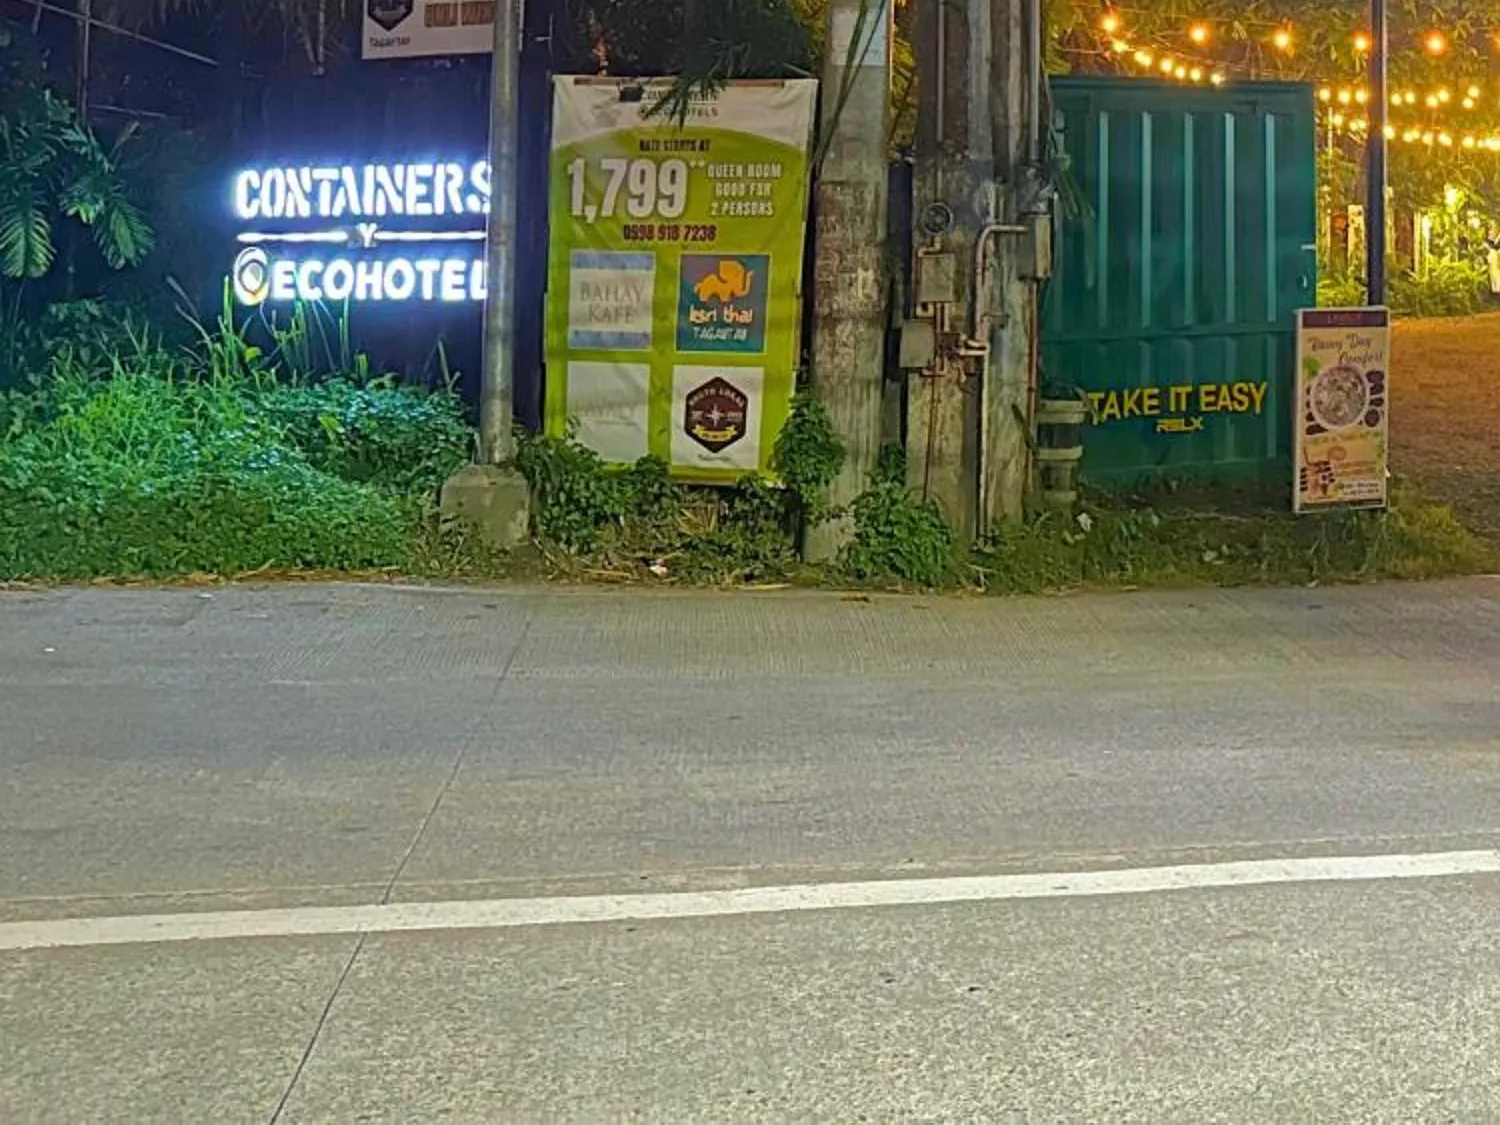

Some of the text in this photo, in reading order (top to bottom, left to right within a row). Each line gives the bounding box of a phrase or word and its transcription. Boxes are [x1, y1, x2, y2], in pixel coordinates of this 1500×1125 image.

[707, 162, 782, 179] QUEEN ROOM
[236, 160, 493, 218] CONTAINERS
[567, 157, 690, 224] 1,799
[721, 200, 774, 216] PERSONS
[580, 282, 645, 302] BAHAY
[588, 306, 635, 324] KAFE
[1086, 382, 1267, 425] TAKE IT EASY
